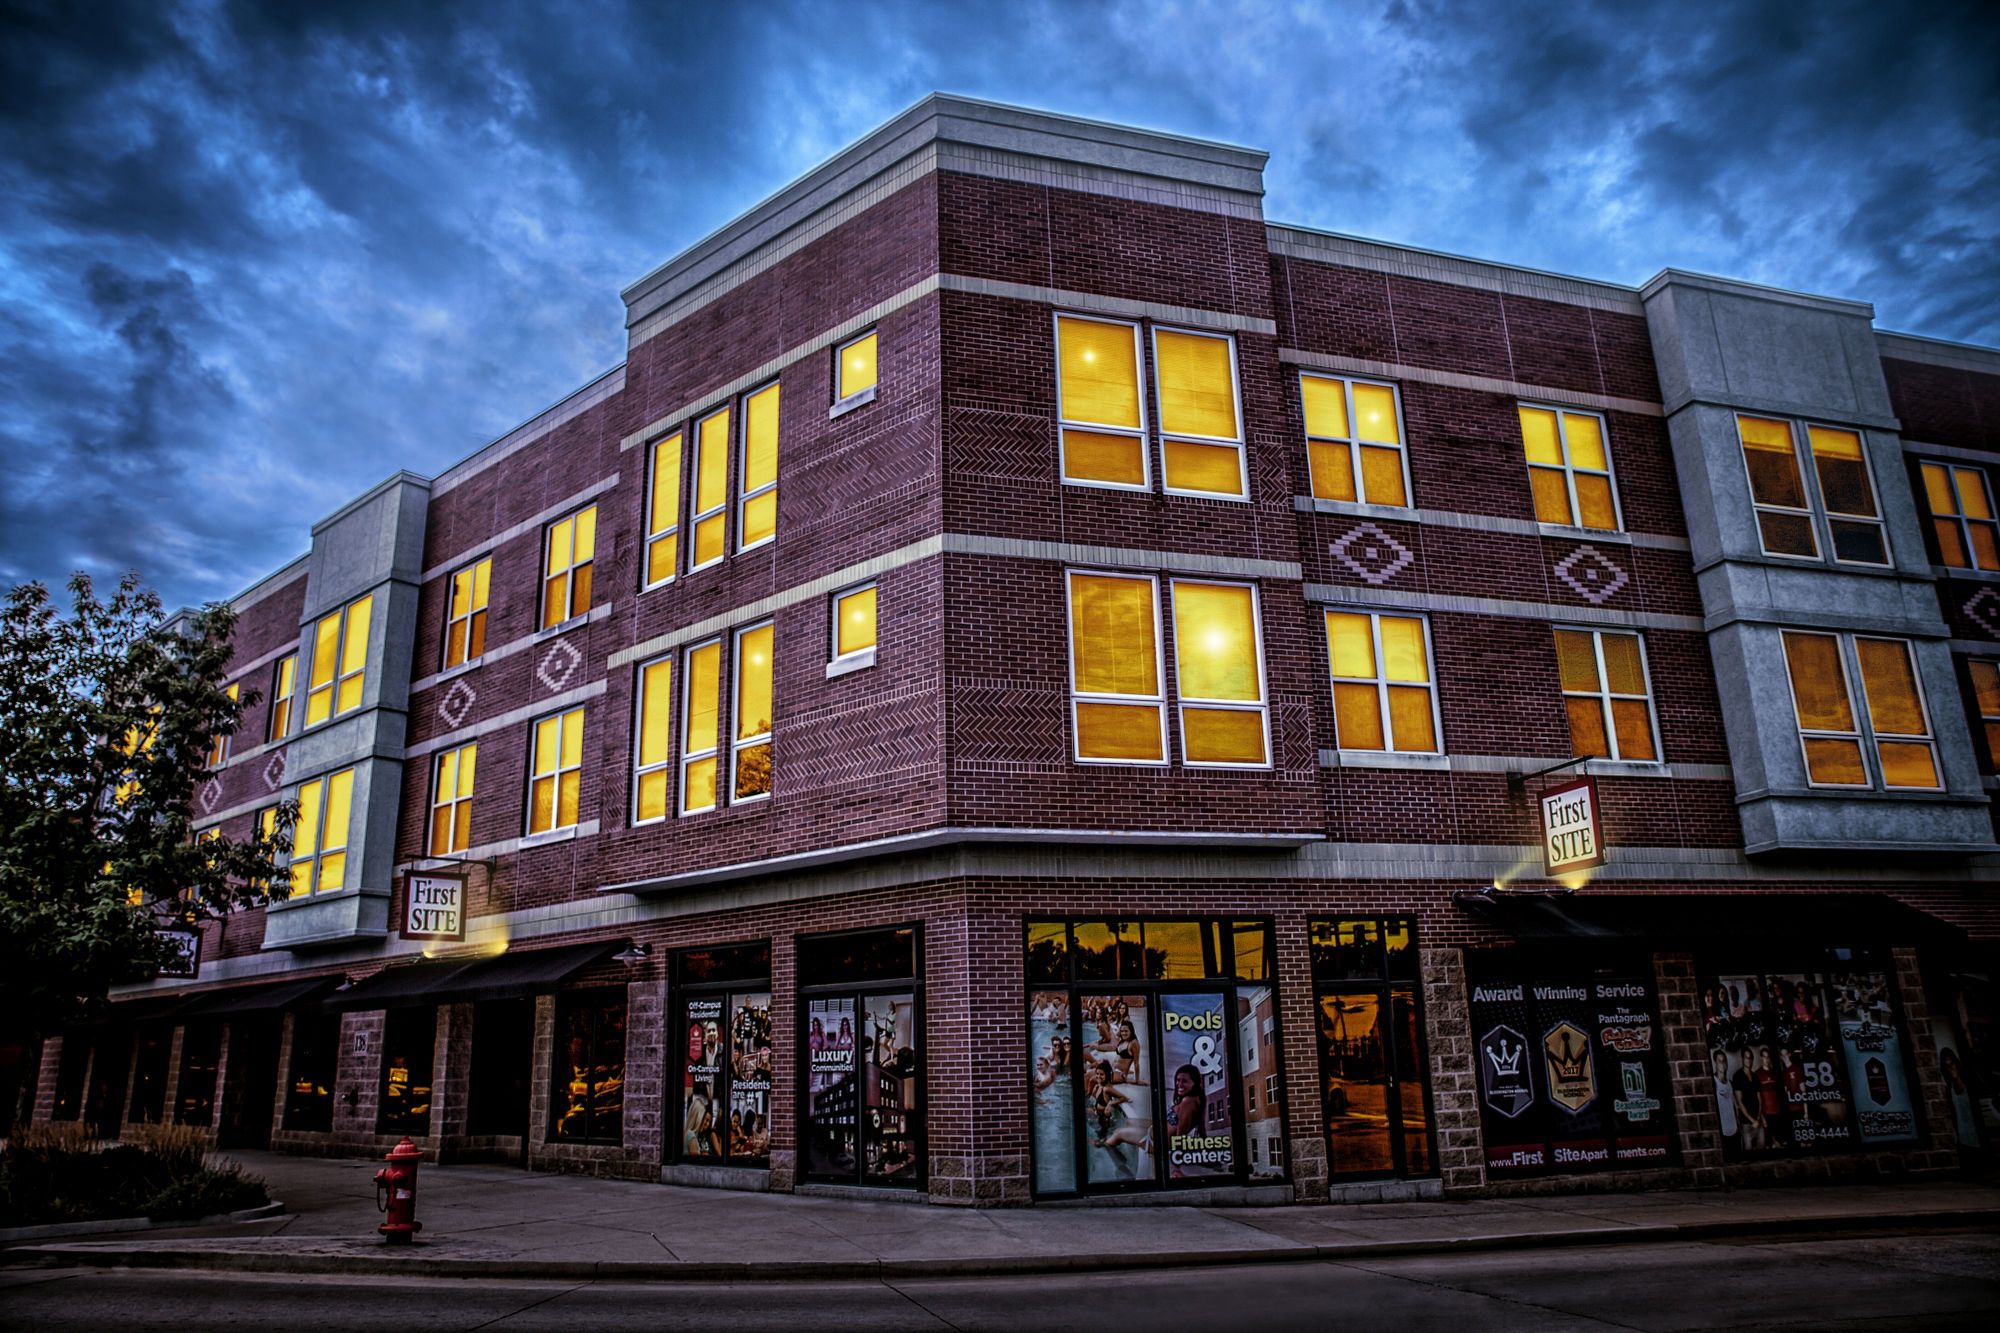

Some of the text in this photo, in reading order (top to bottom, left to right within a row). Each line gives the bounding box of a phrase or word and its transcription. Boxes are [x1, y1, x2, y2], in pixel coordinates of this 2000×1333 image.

[1547, 796, 1588, 829] First
[1551, 828, 1593, 862] SITE
[414, 880, 457, 905] First
[411, 908, 457, 932] SITE
[1473, 983, 1645, 1002] Award Winning Service
[688, 1001, 721, 1010] Off-Campus
[1165, 1011, 1222, 1031] Pools
[1598, 1012, 1650, 1024] Pantagraph
[811, 1048, 853, 1064] Luxury
[1190, 1035, 1223, 1076] &
[688, 1064, 720, 1074] On-Campus
[811, 1064, 854, 1072] Communities
[1562, 1066, 1579, 1075] 2017
[1803, 1061, 1835, 1088] 58
[694, 1074, 713, 1083] Living
[732, 1080, 771, 1091] Residents
[732, 1091, 745, 1099] are
[1794, 1126, 1850, 1141] 888-4444
[1171, 1135, 1231, 1150] Fitness
[1171, 1150, 1232, 1164] Centers
